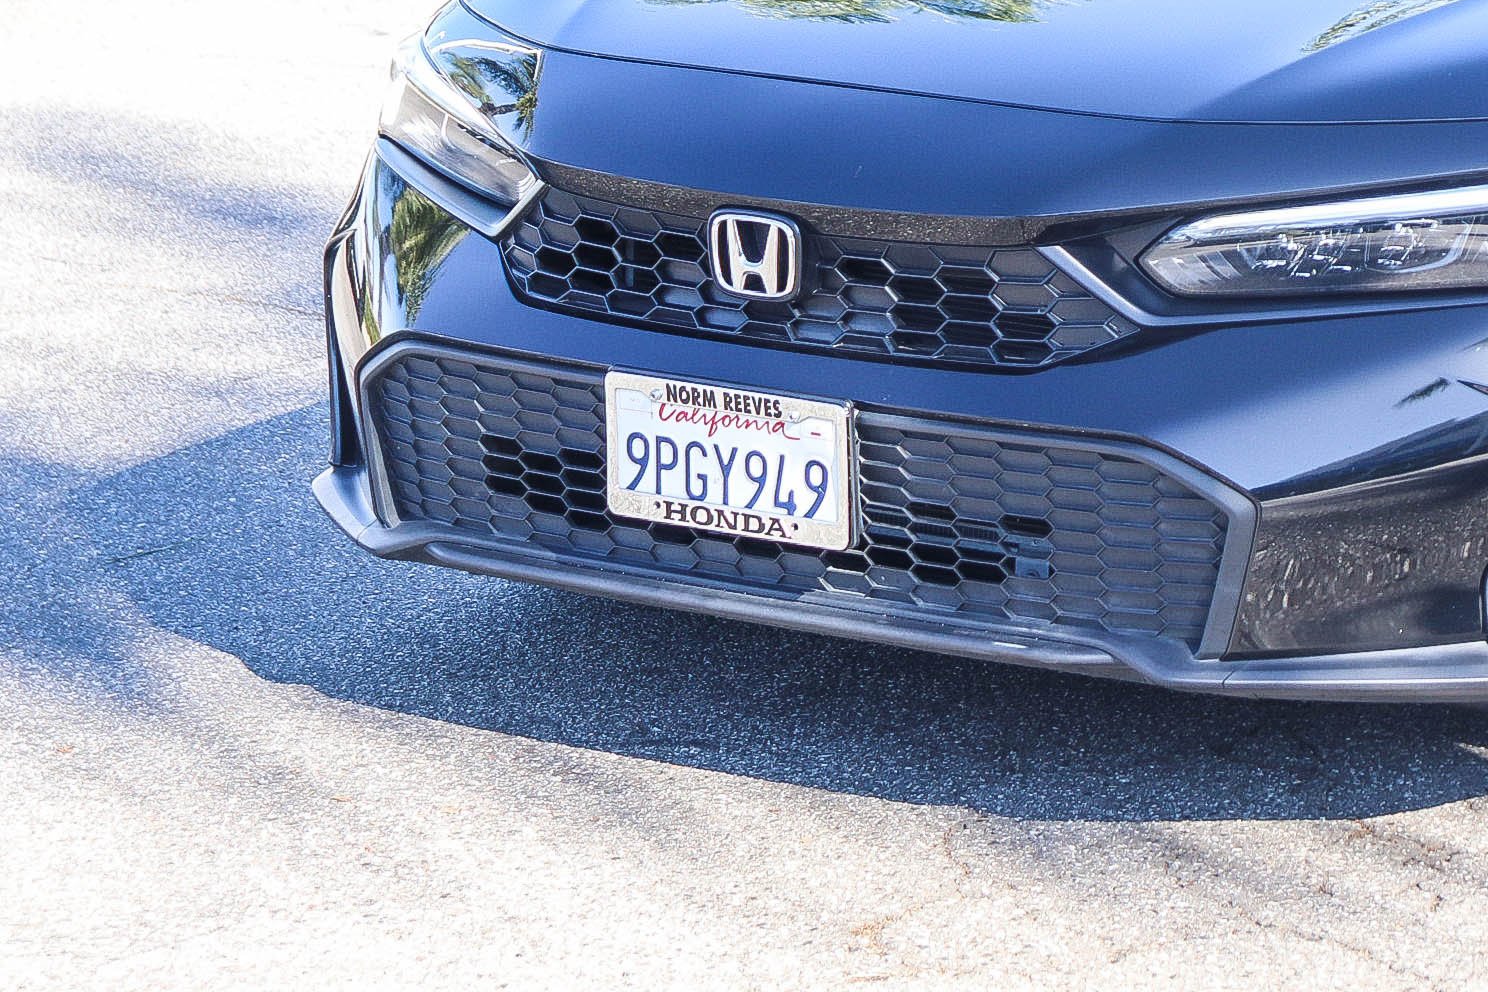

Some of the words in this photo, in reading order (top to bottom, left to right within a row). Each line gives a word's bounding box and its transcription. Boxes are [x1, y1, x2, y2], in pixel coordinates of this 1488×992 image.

[665, 383, 718, 410] NORM
[723, 391, 783, 419] REEVES
[658, 402, 801, 440] California
[626, 431, 829, 519] 9PGY949
[663, 500, 792, 540] HONDA
